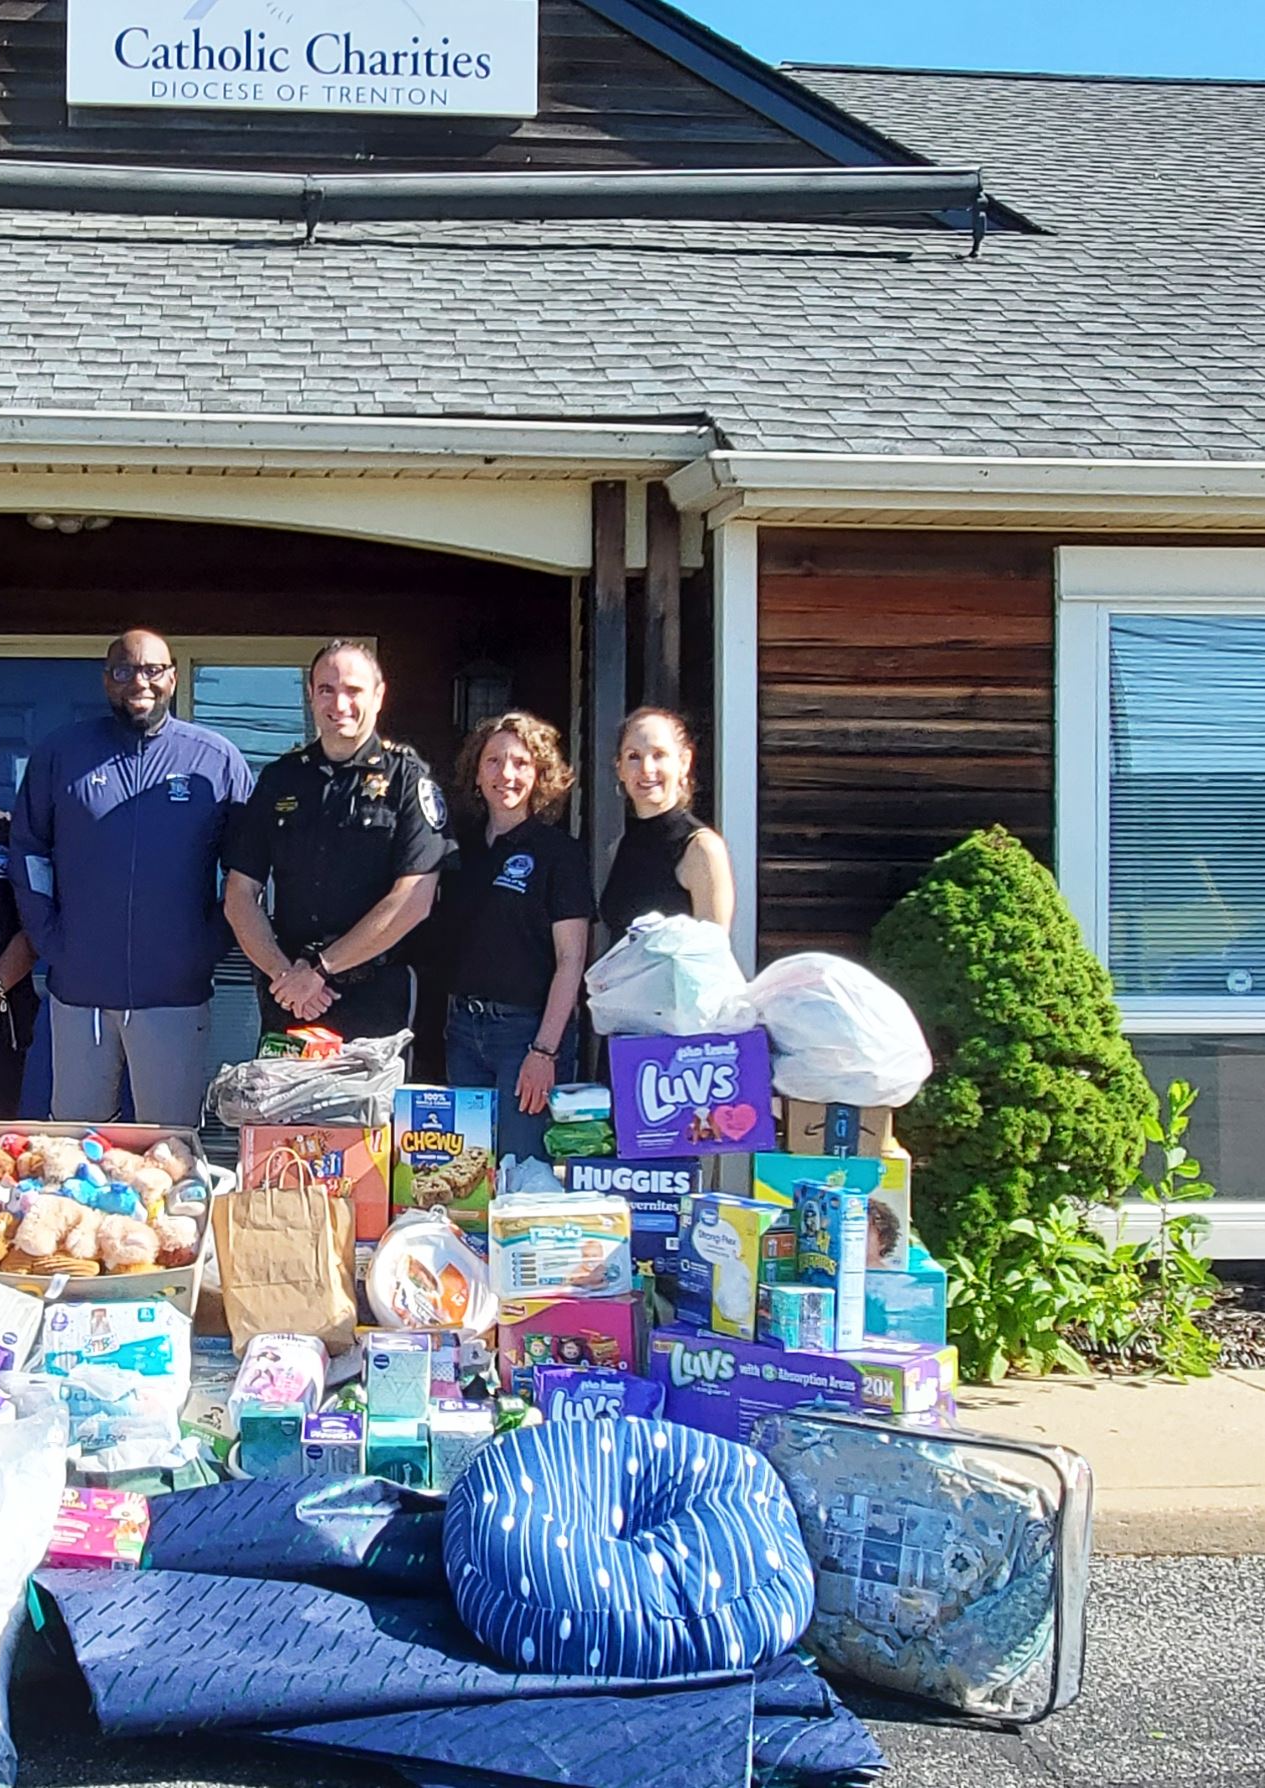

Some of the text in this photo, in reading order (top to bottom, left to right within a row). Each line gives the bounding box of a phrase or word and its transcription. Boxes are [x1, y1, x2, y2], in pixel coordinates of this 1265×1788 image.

[113, 26, 492, 80] Catholic Charities
[151, 80, 449, 106] DIOCESE OF TRENTON
[572, 1165, 690, 1195] HUGGIES
[629, 1199, 679, 1213] vernites
[777, 1367, 829, 1389] Absorption
[829, 1375, 857, 1392] Areas
[861, 1375, 895, 1399] 20X
